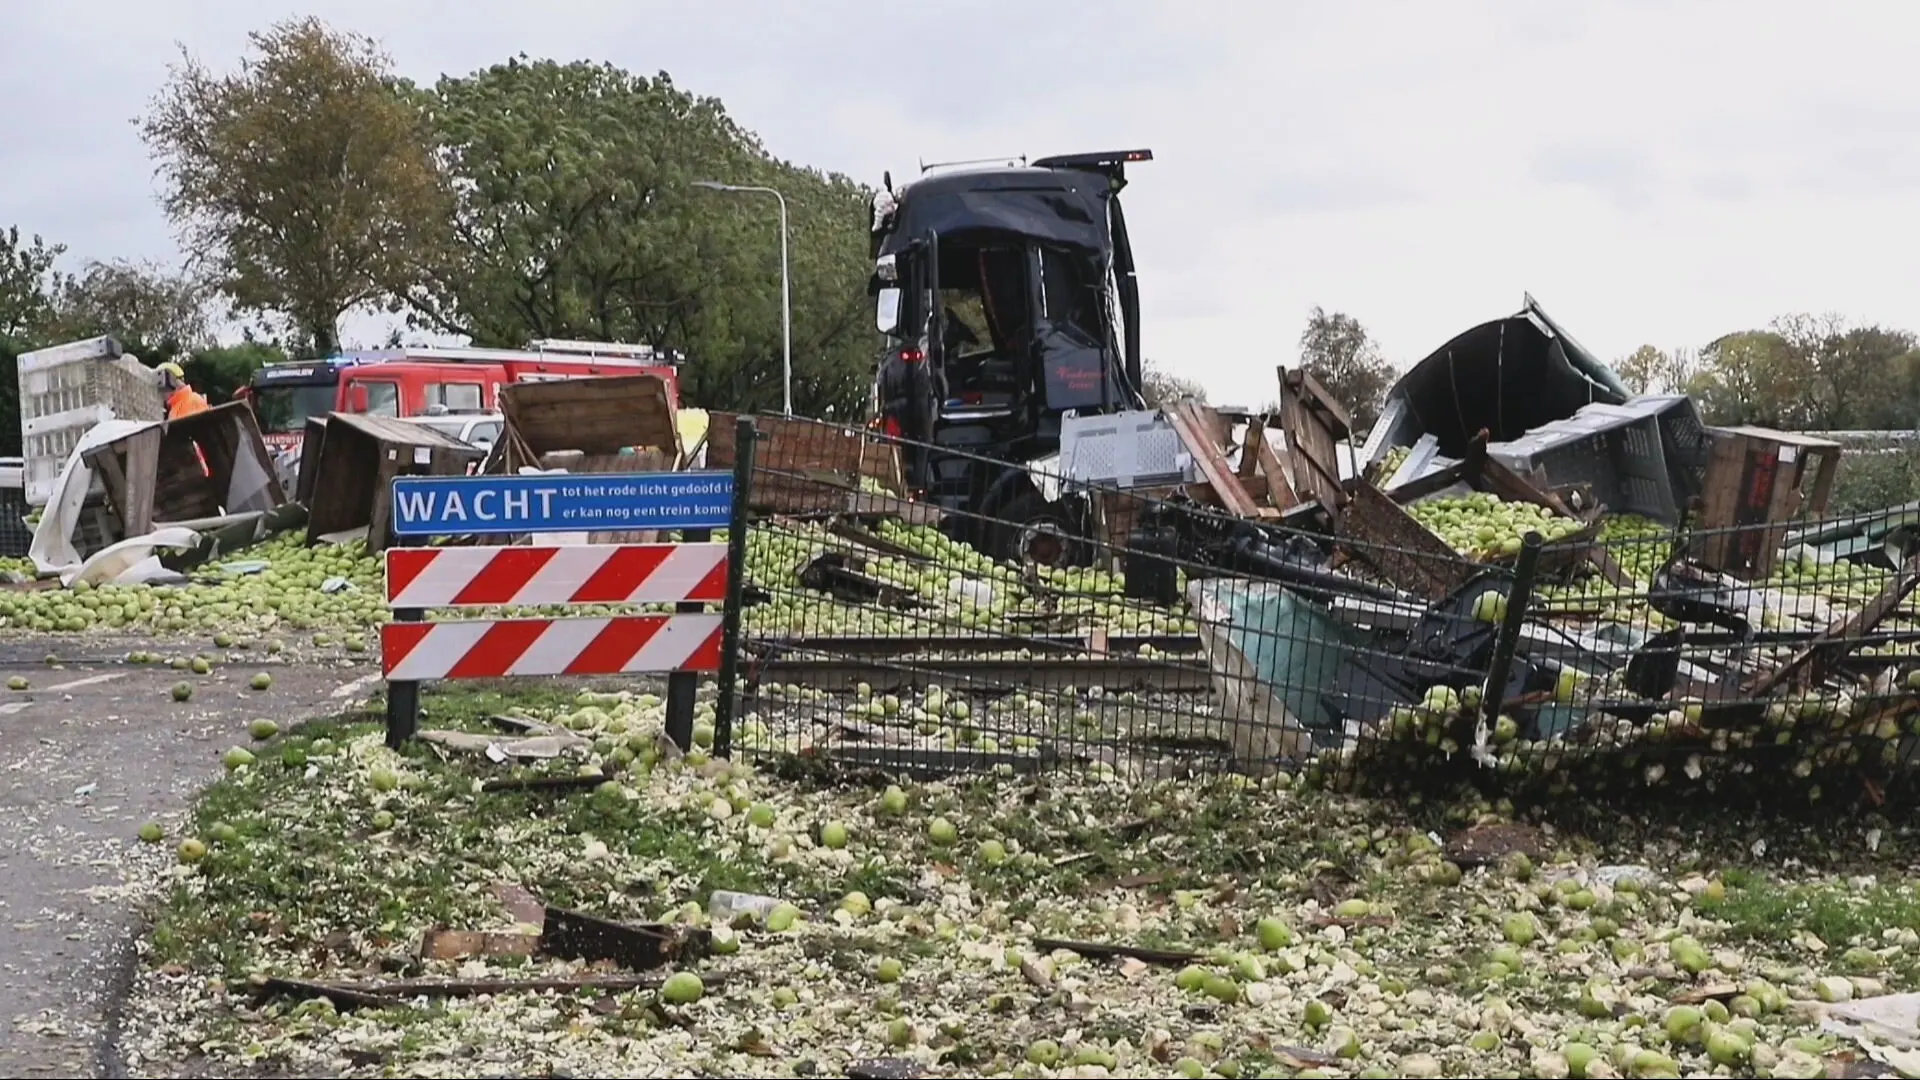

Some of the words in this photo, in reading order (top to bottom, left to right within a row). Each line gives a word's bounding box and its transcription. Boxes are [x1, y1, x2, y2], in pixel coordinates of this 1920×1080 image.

[562, 486, 581, 497] tot
[584, 485, 605, 496] het
[608, 484, 637, 496] rode
[640, 483, 668, 496] licht
[671, 482, 721, 497] gedoofd
[397, 488, 558, 523] WACHT
[563, 508, 576, 518] er
[580, 506, 602, 518] kan
[606, 508, 630, 519] nog
[633, 507, 656, 516] een
[660, 504, 690, 516] trein
